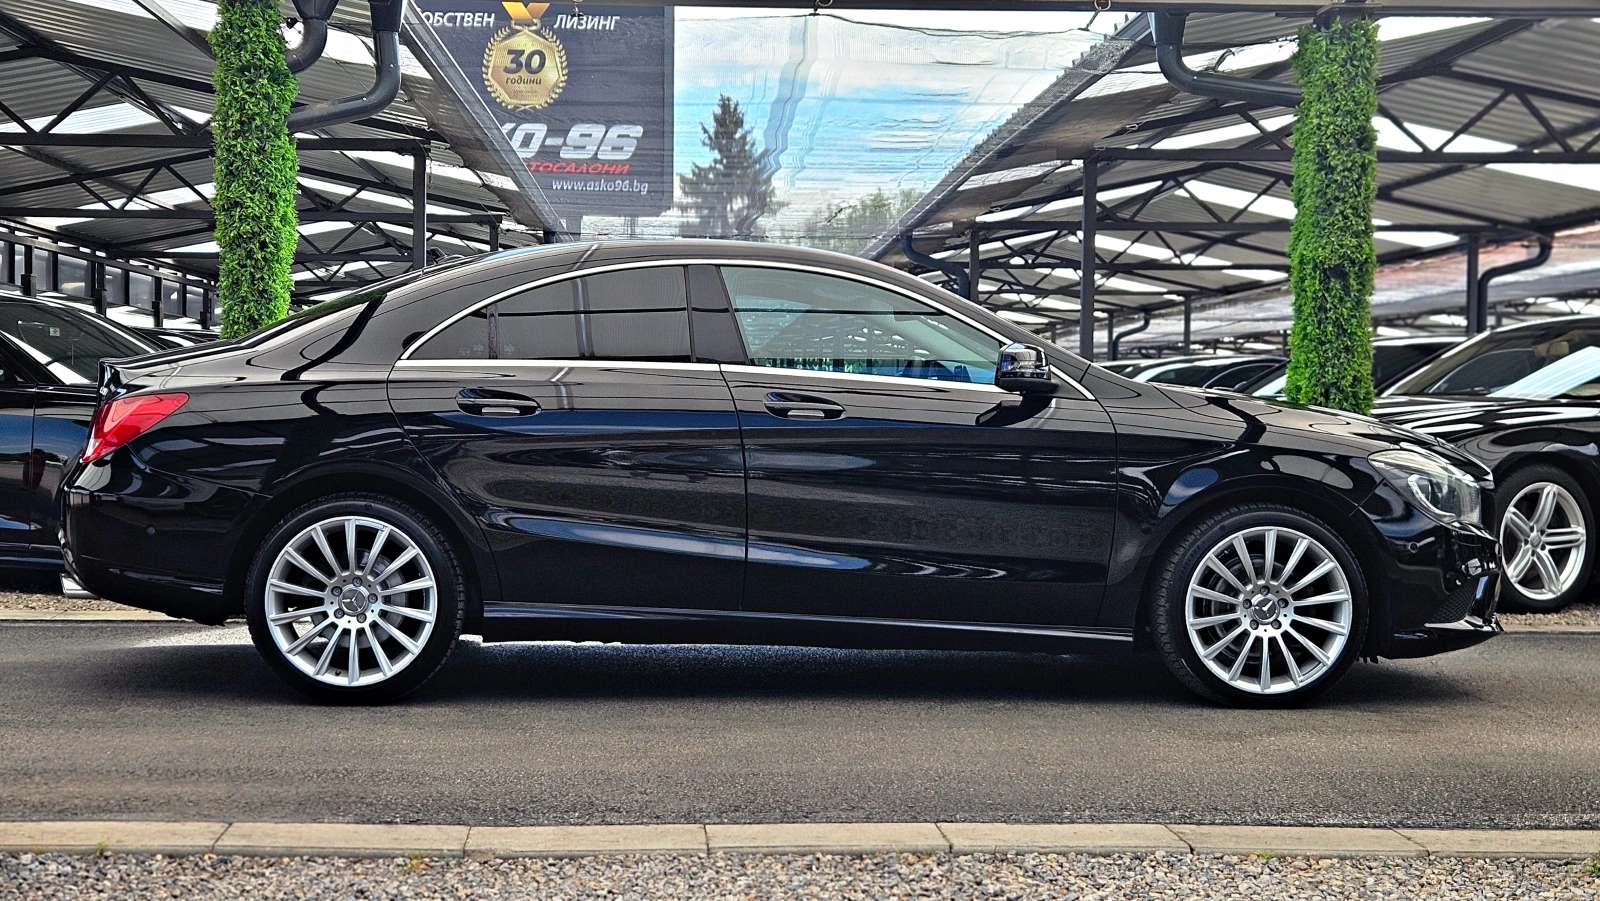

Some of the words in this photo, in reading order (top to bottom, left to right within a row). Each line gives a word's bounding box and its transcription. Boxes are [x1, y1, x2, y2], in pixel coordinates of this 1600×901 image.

[418, 9, 496, 27] ОБСТВЕН
[553, 14, 620, 30] ЛИЗИНГ
[503, 49, 546, 75] 30
[505, 76, 542, 85] години
[501, 122, 644, 160] O-96
[524, 161, 631, 175] ТОСАЛОНИ
[552, 178, 649, 195] www.asko96.bg
